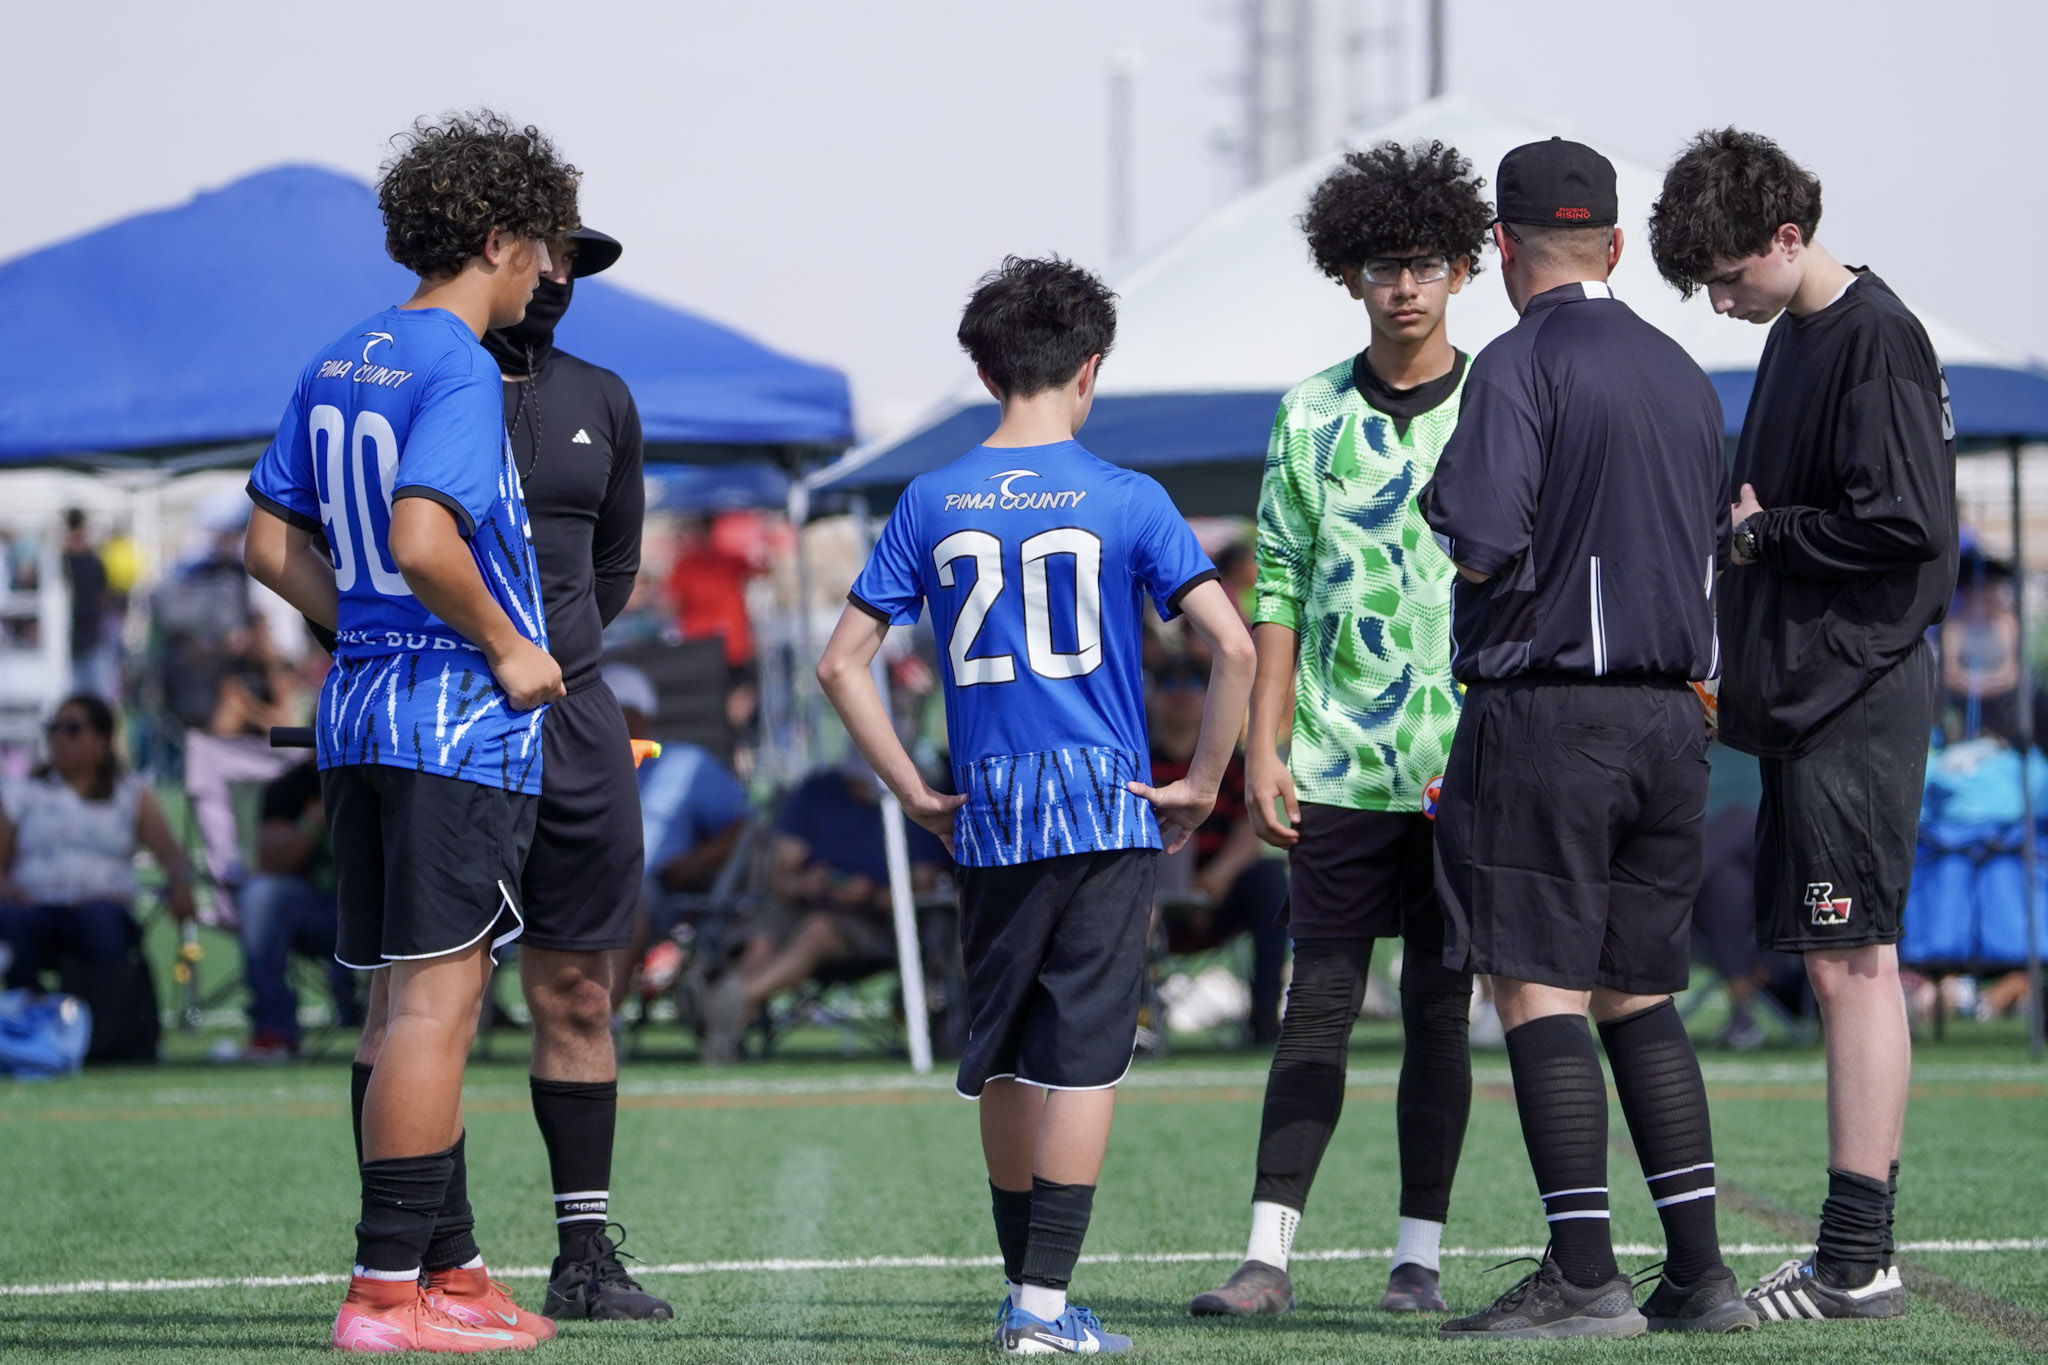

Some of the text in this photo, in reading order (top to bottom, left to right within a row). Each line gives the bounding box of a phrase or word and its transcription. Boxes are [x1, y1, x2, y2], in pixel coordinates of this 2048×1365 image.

[1555, 211, 1591, 219] RISING
[316, 359, 414, 390] PIMA COUNTY
[308, 404, 413, 596] 90
[944, 490, 1087, 512] PIMA COUNTY
[932, 526, 1103, 688] 20
